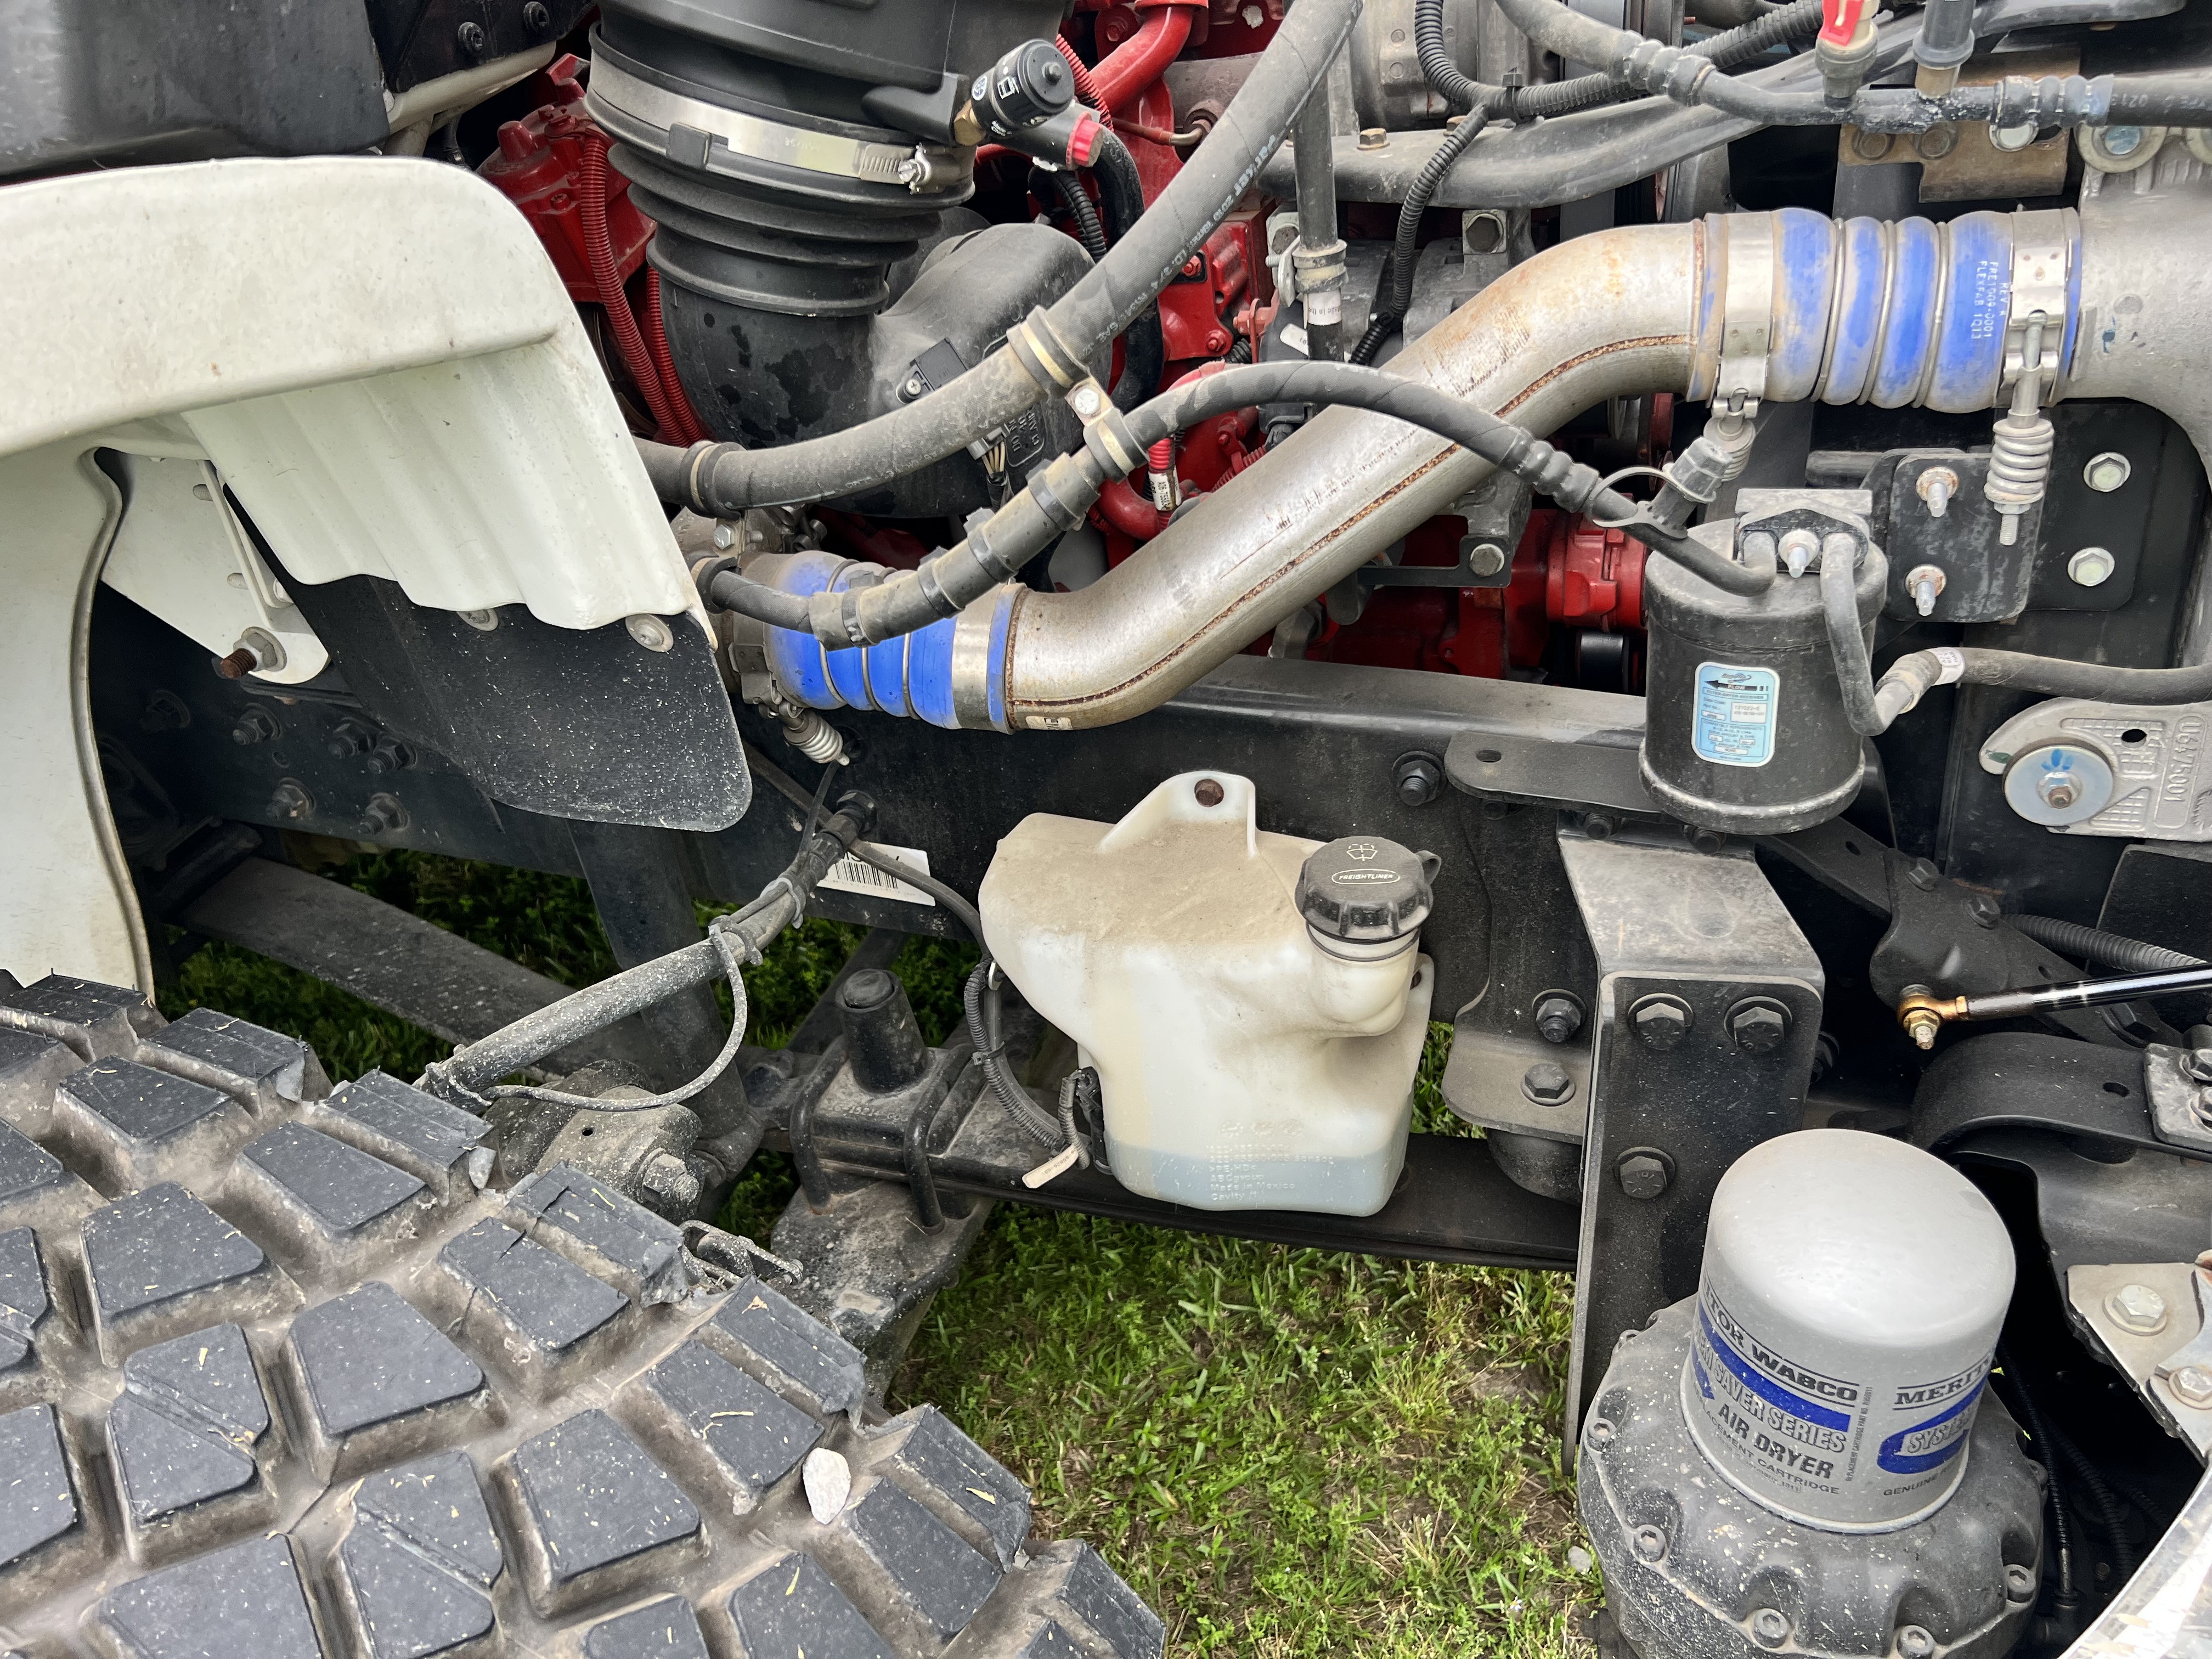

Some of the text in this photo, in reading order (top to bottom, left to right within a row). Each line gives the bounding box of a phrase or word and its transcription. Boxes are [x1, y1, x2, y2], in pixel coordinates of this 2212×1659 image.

[1234, 134, 1276, 195] Parker
[1974, 261, 1987, 306] FLEXFAB
[1999, 283, 2008, 303] REV
[1211, 1192, 1245, 1201] Cavity
[1256, 1182, 1295, 1190] Mexico
[1751, 1343, 1858, 1403] WABCO
[1713, 1357, 1765, 1421] SAVER
[1767, 1406, 1846, 1453] SERIES
[1718, 1403, 1833, 1479] AIR DRYER
[1757, 1458, 1839, 1494] CARTRIDGE
[1883, 1473, 1937, 1496] GENUINE
